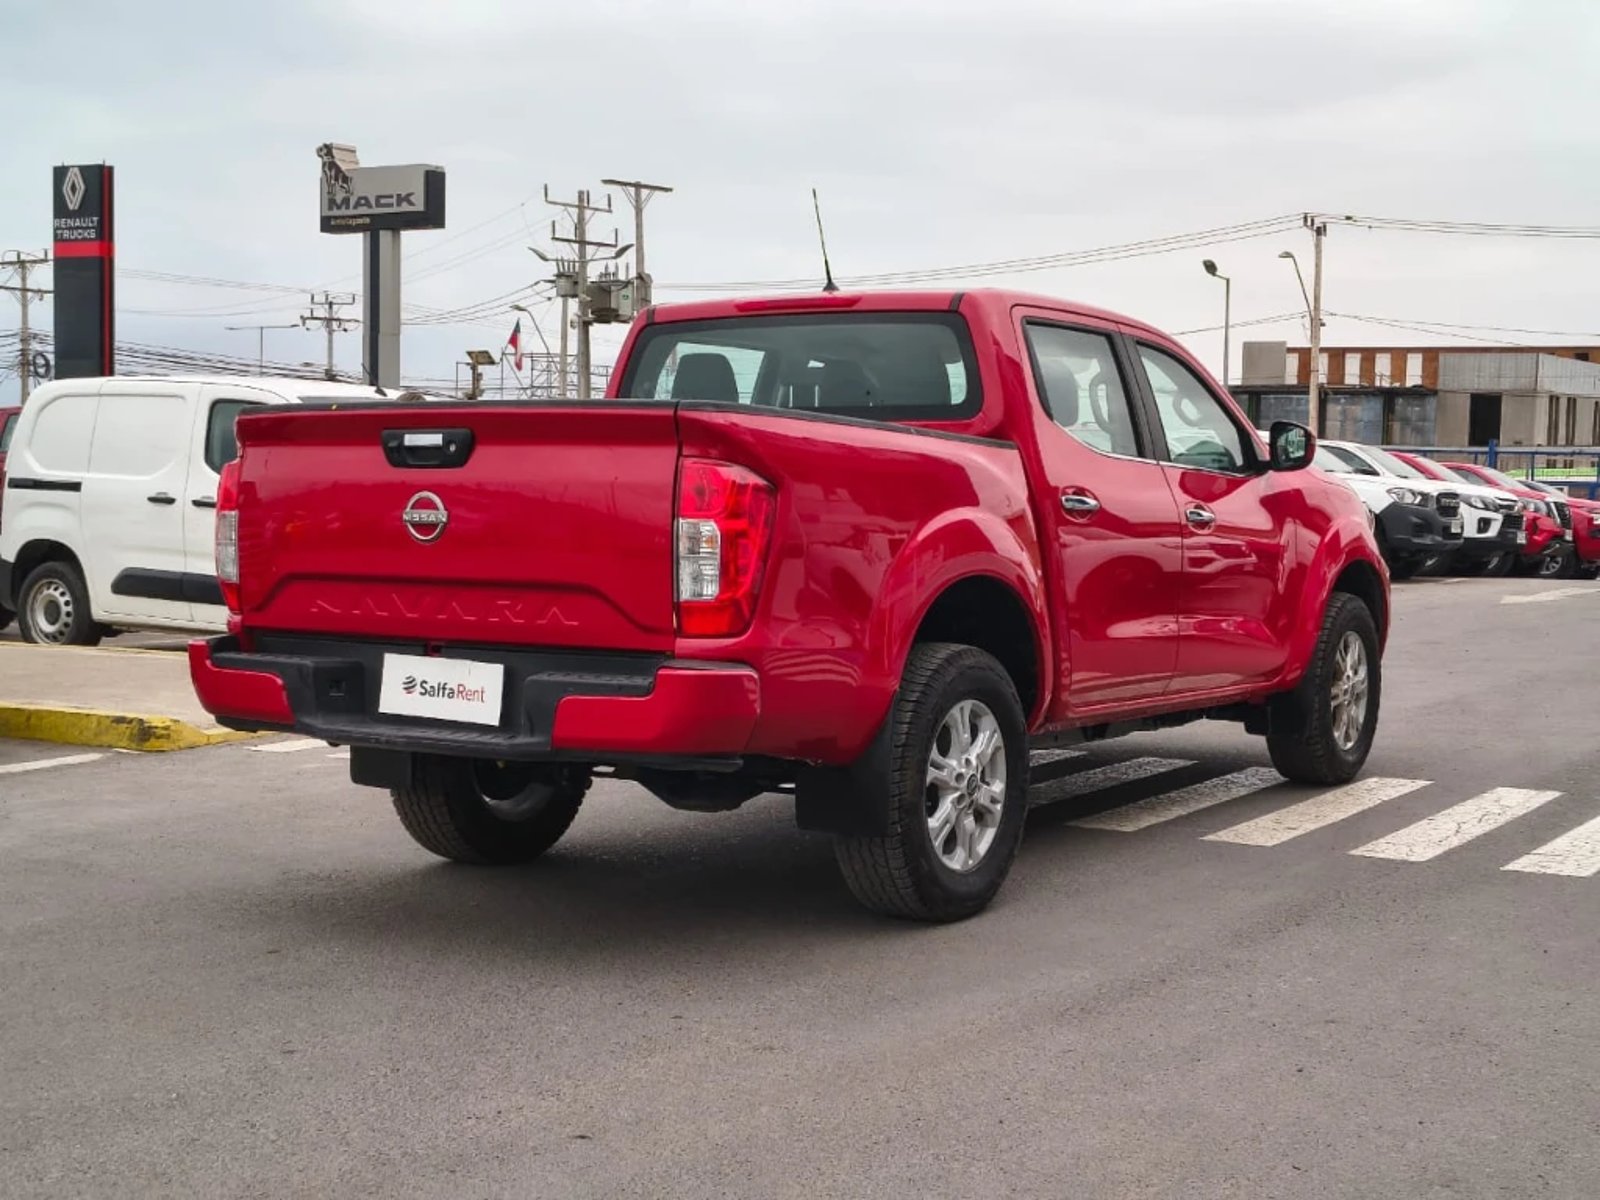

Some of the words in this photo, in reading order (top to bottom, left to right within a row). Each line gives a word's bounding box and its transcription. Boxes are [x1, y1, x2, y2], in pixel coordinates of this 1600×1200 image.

[327, 192, 416, 211] MACK
[54, 217, 99, 228] RENAULT
[55, 229, 96, 240] TRUCKS
[309, 593, 580, 626] NAVARA
[419, 680, 485, 703] SalfaRent
